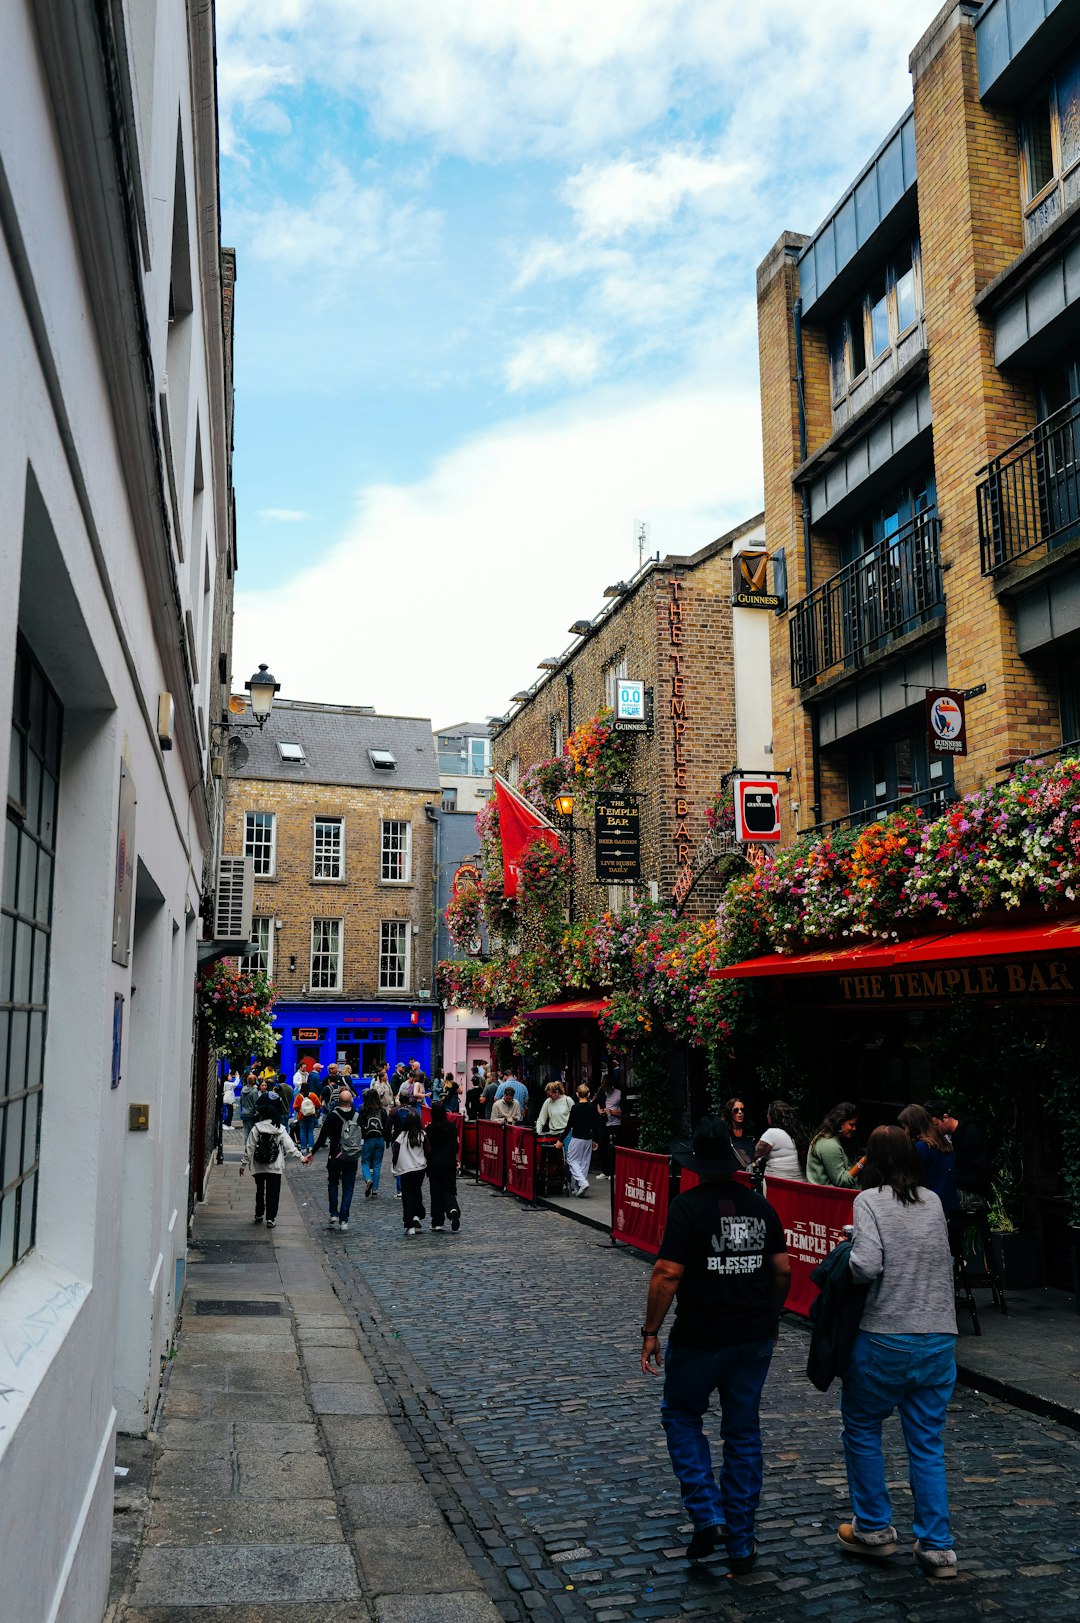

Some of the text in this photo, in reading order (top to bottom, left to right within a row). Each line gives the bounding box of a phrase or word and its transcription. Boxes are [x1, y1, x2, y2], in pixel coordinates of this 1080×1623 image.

[737, 593, 779, 605] GUINNESS
[621, 690, 641, 703] 0.0
[615, 722, 648, 731] GUINNESS
[669, 580, 691, 865] THE TEMPLE BAR
[934, 739, 963, 747] GUINNESS
[597, 806, 639, 816] TEMPLE
[606, 816, 630, 826] BAR
[839, 960, 1074, 999] THE TEMPLE BAR
[808, 1221, 828, 1238] THE
[784, 1228, 828, 1256] TEMPLE
[706, 1254, 763, 1271] BLESSED
